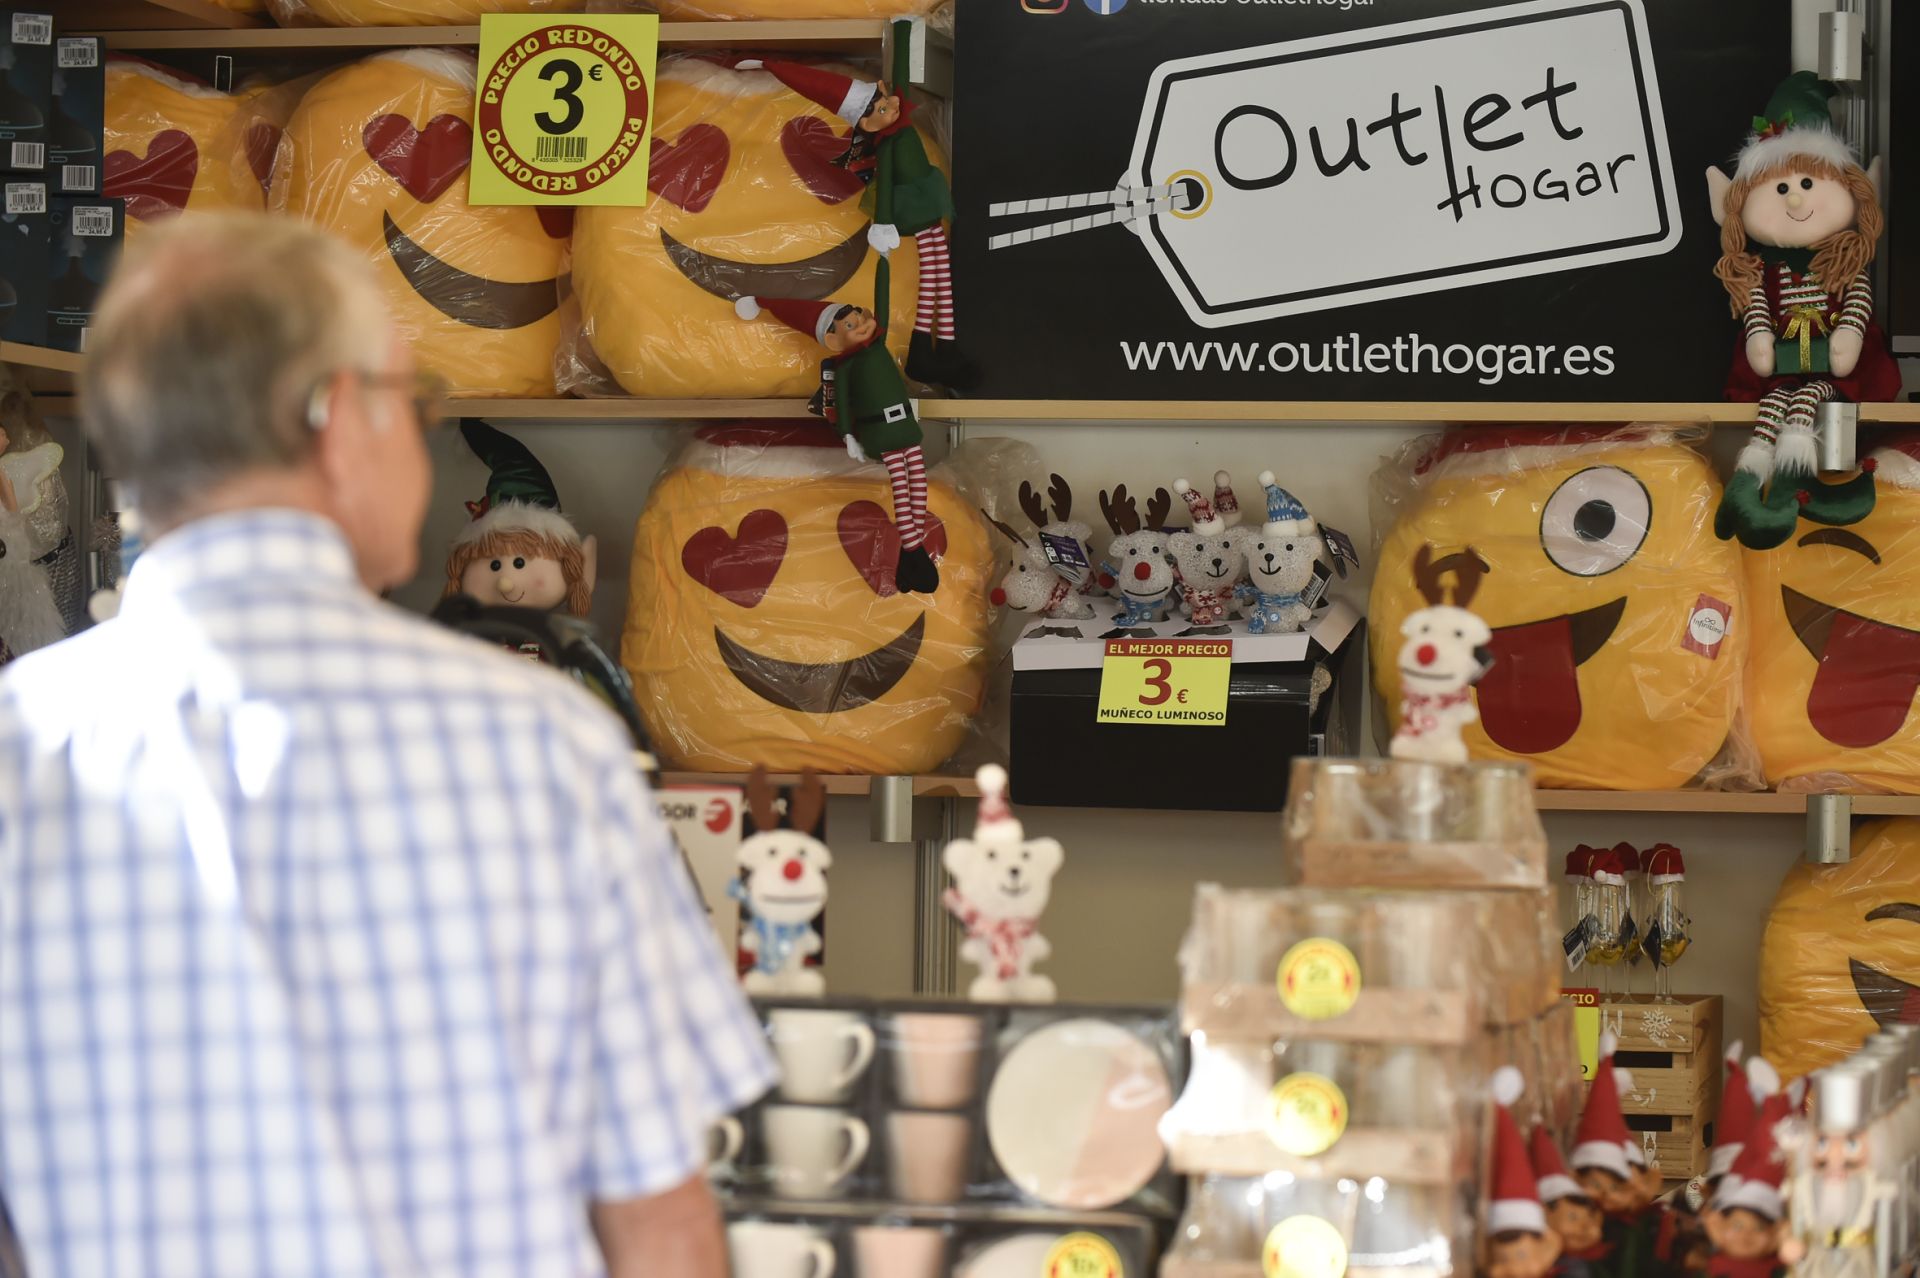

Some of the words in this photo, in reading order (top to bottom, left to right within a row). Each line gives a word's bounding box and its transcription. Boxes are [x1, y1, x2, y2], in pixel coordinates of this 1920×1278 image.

[484, 37, 540, 105] PRECIO
[547, 28, 641, 91] REDONDO
[534, 58, 584, 135] 3
[588, 64, 603, 81] €
[486, 128, 577, 191] REDONDO
[585, 117, 643, 183] PRECIO
[1214, 66, 1584, 223] Outlet
[1120, 333, 1616, 386] www.outlethogar.es
[1109, 644, 1124, 654] EL
[1128, 644, 1173, 655] MEJOR
[1178, 645, 1229, 656] PRECIO
[1138, 658, 1172, 706] 3
[1177, 688, 1189, 704] €
[1100, 707, 1153, 719] MUÑECO
[1157, 710, 1225, 721] LUMINOSO
